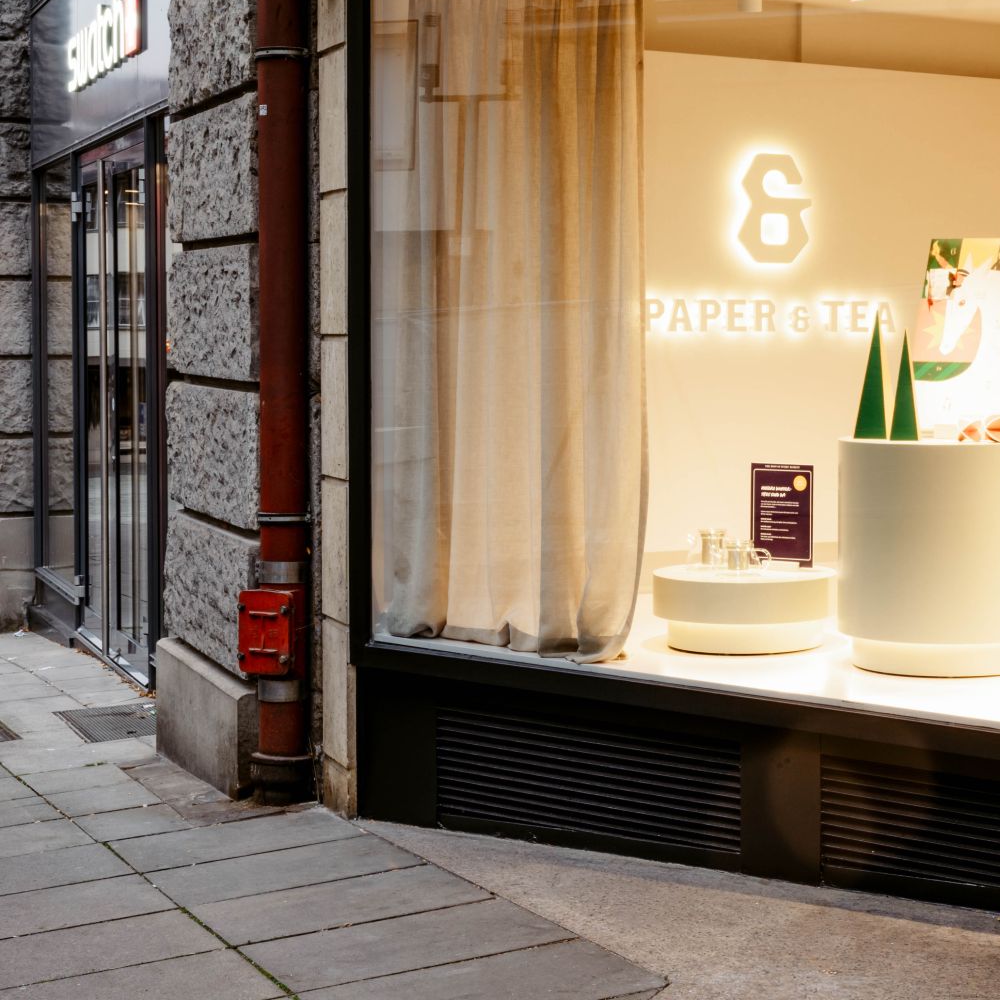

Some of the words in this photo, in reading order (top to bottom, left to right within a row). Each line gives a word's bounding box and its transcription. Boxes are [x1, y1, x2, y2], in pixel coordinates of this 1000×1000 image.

[737, 153, 812, 264] &
[645, 298, 776, 333] PAPER
[791, 306, 811, 333] &
[822, 300, 897, 333] TEA
